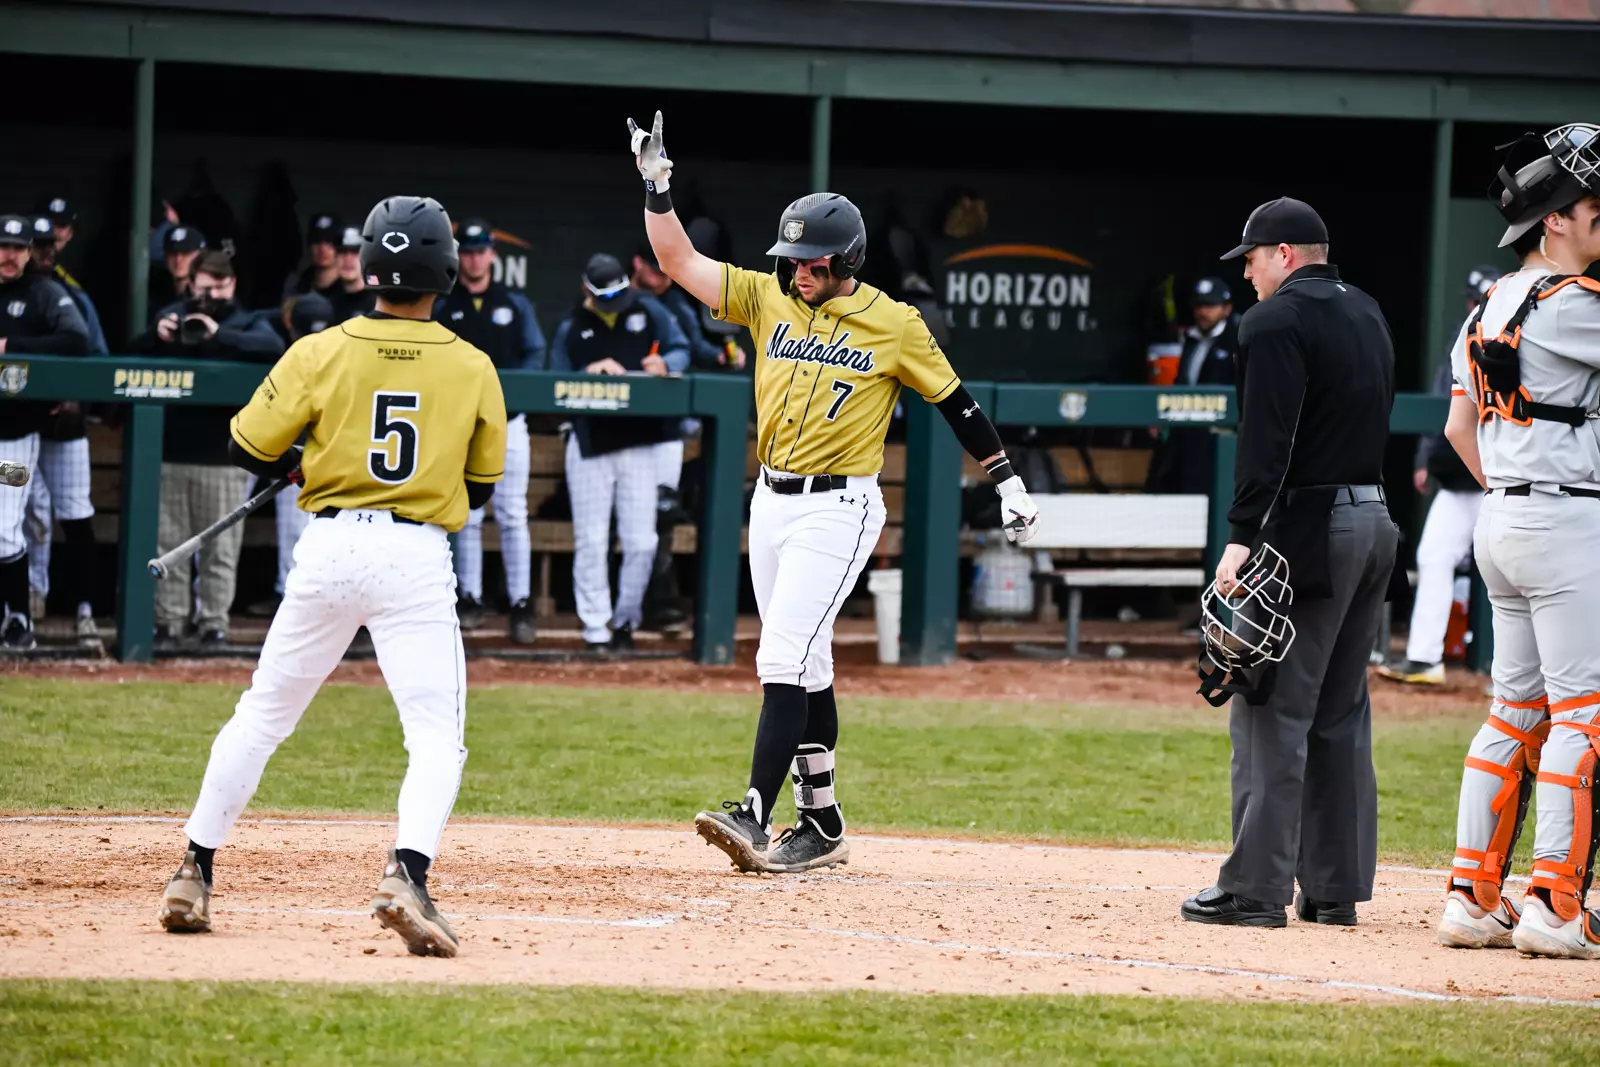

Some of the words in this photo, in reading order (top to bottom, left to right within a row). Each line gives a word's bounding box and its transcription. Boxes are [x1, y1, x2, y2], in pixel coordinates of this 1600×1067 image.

[392, 272, 401, 285] 5
[947, 272, 1091, 307] HORIZON
[946, 308, 1089, 331] LEAGUE
[377, 348, 422, 356] PURDUE
[766, 321, 875, 374] Mastodons
[114, 368, 195, 389] PURDUE
[554, 381, 631, 401] PURDUE
[825, 379, 855, 422] 7
[1157, 394, 1228, 412] PURDUE
[367, 390, 420, 485] 5
